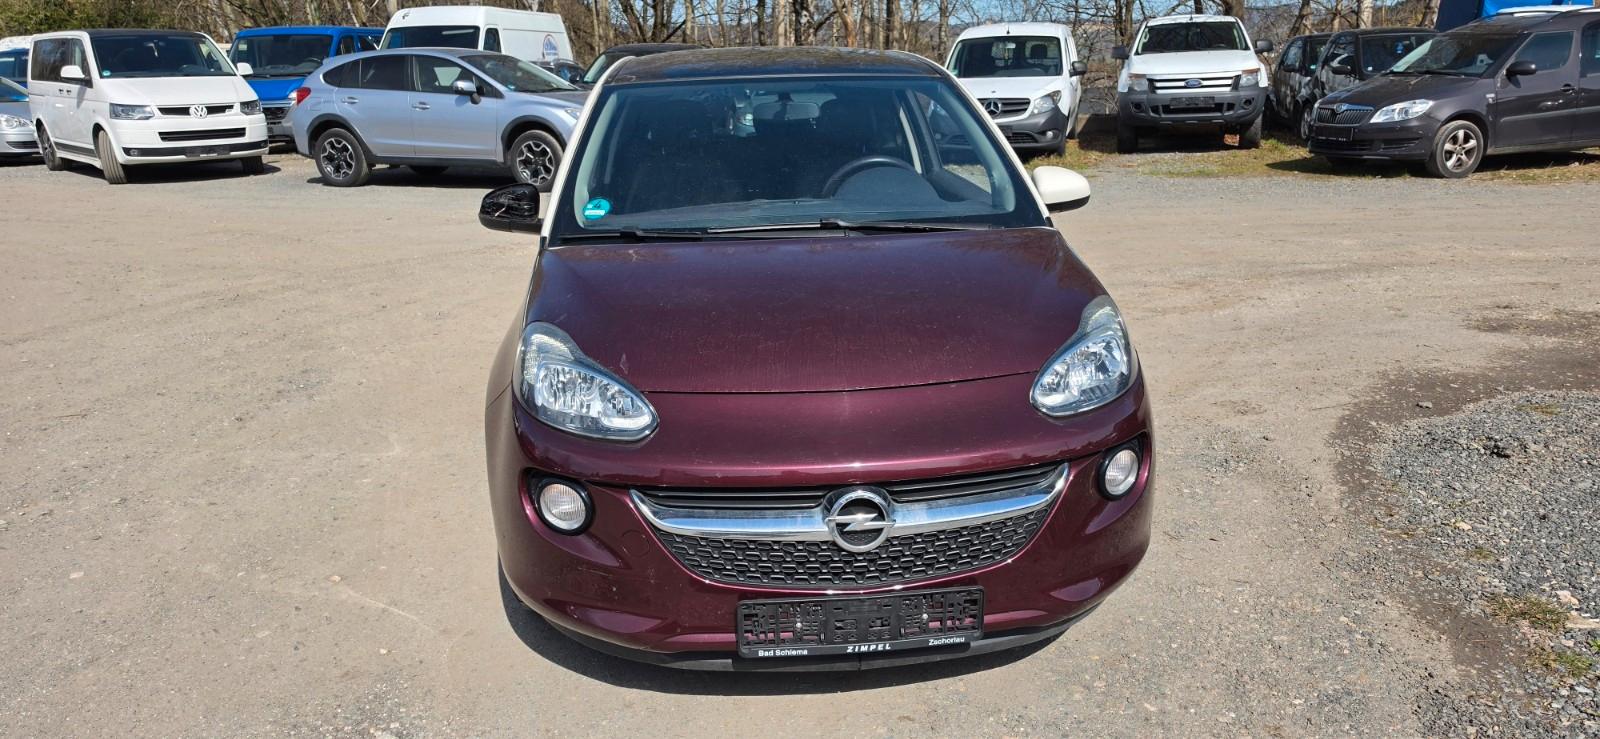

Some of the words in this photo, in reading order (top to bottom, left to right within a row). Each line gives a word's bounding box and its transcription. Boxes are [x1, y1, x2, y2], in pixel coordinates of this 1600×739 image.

[928, 637, 965, 646] Zschorlau
[846, 643, 891, 653] ZIMPEL
[758, 649, 774, 657] Bad
